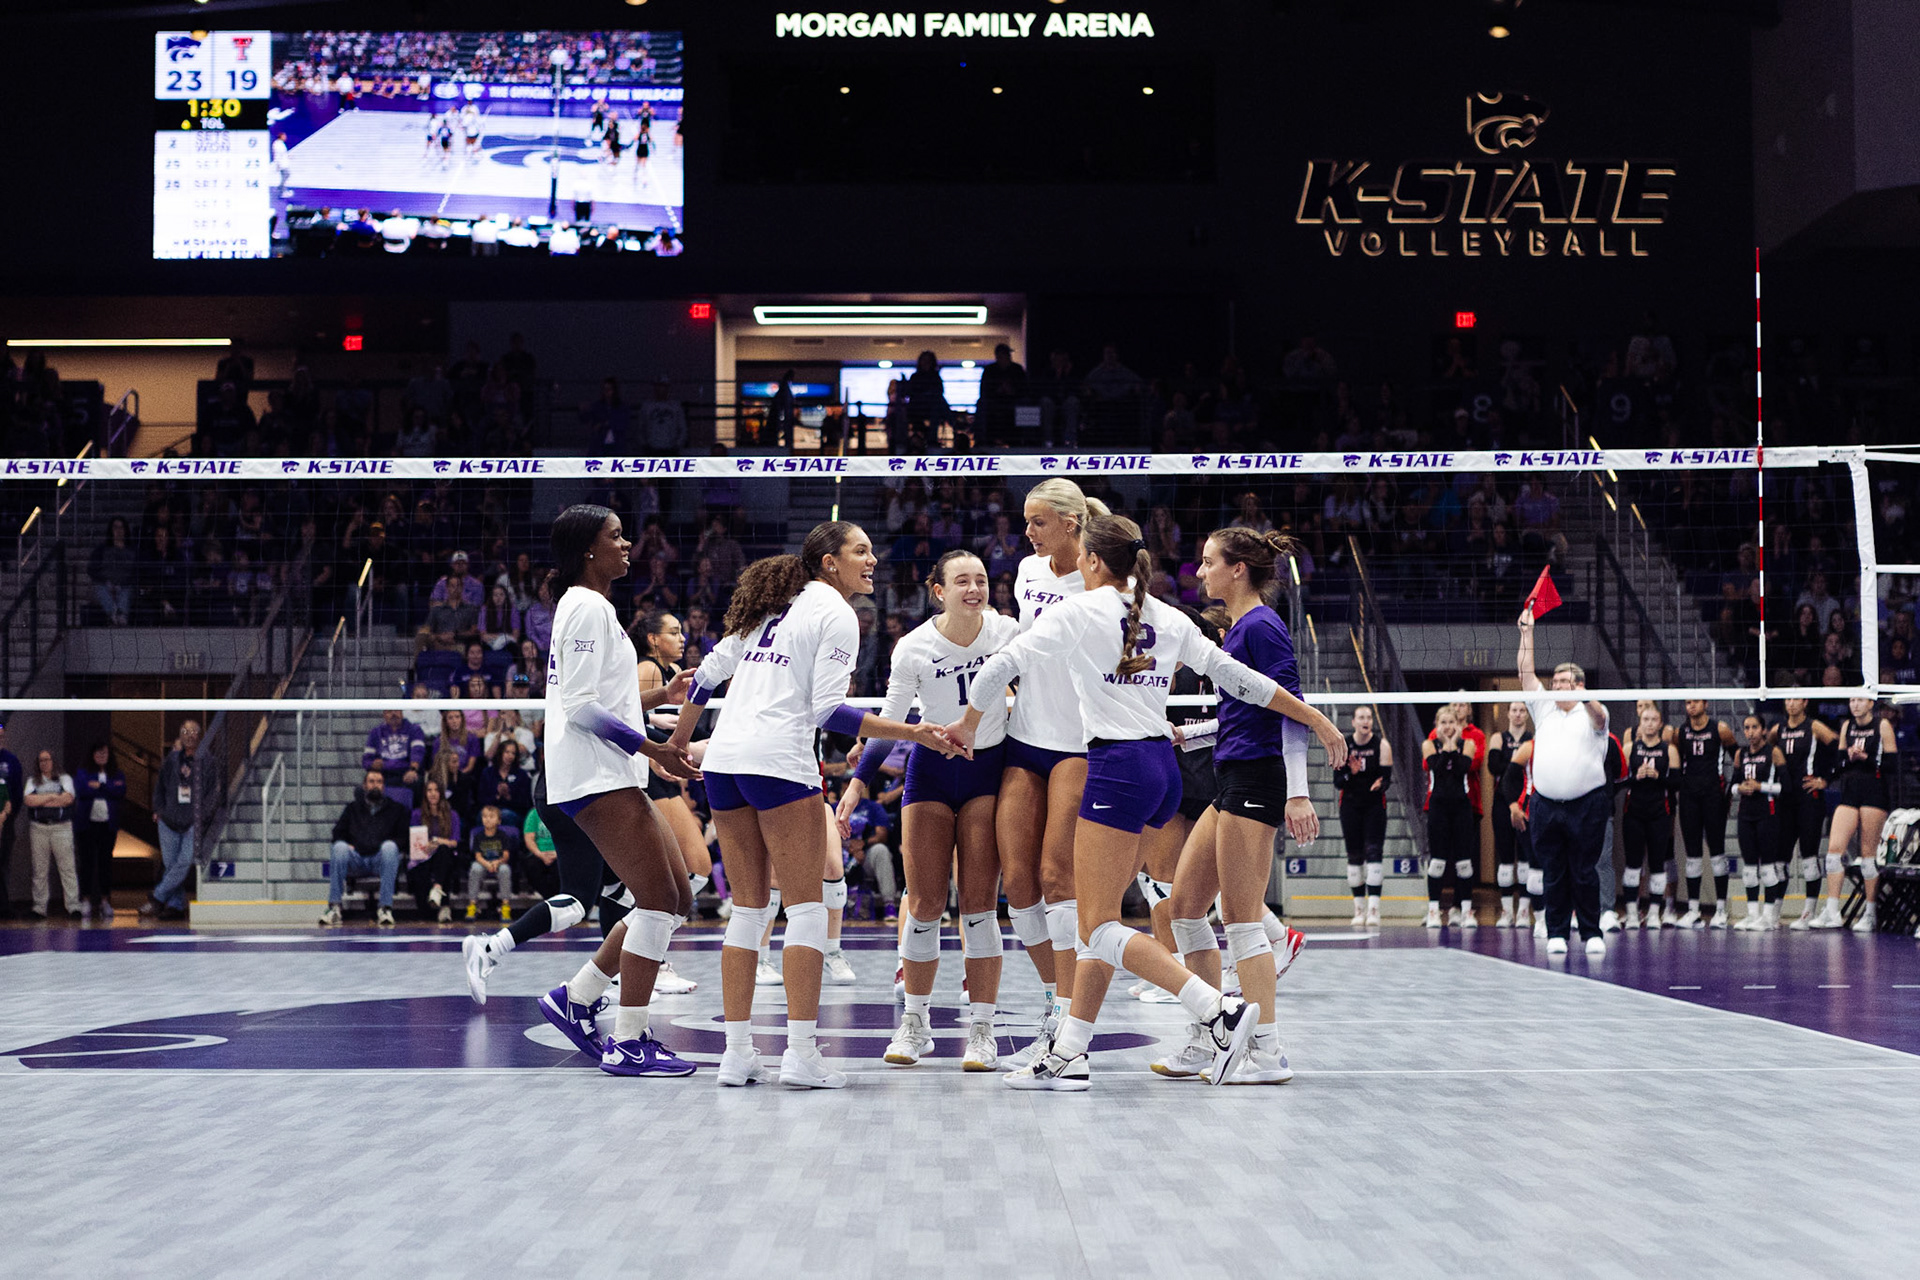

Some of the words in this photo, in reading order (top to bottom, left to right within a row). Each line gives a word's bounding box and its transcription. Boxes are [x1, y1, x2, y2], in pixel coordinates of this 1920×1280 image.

[775, 12, 916, 38] MORGAN
[923, 12, 1037, 38] FAMILY
[1042, 12, 1155, 38] ARENA
[167, 70, 203, 91] 23
[226, 70, 258, 91] 19
[187, 99, 241, 117] 1:30
[1296, 159, 1677, 224] K-STATE
[1324, 229, 1649, 256] VOLLEYBALL
[914, 457, 1000, 471] K-STATE
[1066, 456, 1152, 470] K-STATE
[1217, 455, 1303, 468] K-STATE
[1368, 454, 1454, 467] K-STATE
[1520, 452, 1604, 466] K-STATE
[1670, 450, 1754, 464] K-STATE
[5, 460, 91, 474] K-STATE
[156, 460, 241, 474] K-STATE
[307, 460, 393, 474] K-STATE
[458, 459, 545, 473] K-STATE
[610, 459, 696, 473] K-STATE
[762, 458, 848, 472] K-STATE
[1023, 588, 1064, 605] K-STA
[1692, 740, 1705, 756] 13
[218, 861, 228, 877] 7
[1289, 859, 1300, 874] 6
[1400, 859, 1411, 874] 8
